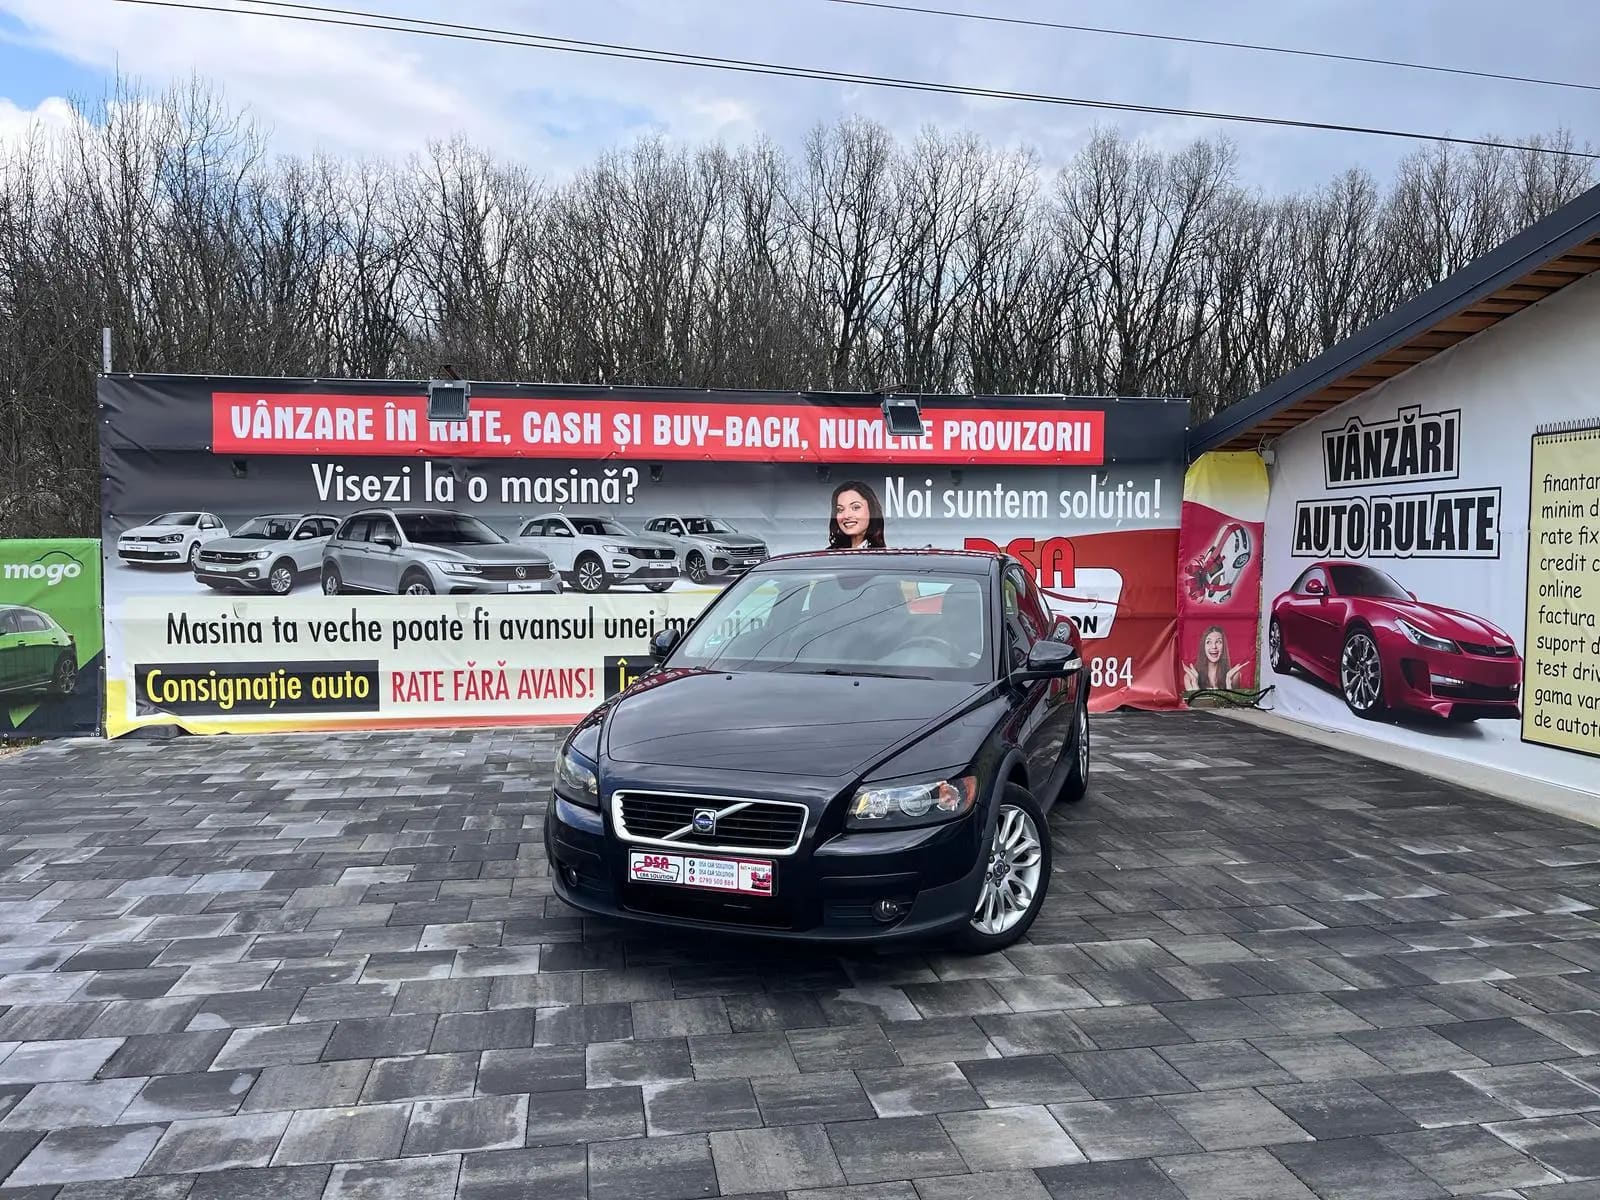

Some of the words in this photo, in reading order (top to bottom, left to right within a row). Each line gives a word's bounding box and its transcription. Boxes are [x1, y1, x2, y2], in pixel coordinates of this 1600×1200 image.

[231, 399, 374, 441] VÂNZARE
[384, 402, 416, 441] ÎN
[429, 411, 511, 445] RATE,
[523, 411, 601, 444] CASH
[613, 413, 641, 452] ȘI
[653, 415, 808, 450] BUY-BACK,
[944, 420, 1091, 452] PROVIZORII
[1327, 413, 1455, 482] VÂNZĂRI
[311, 463, 410, 502] Visezi
[424, 461, 454, 502] la
[468, 476, 488, 503] o
[501, 466, 639, 511] mașină?
[885, 476, 932, 518] Noi
[943, 483, 1048, 518] suntem
[1060, 474, 1161, 527] soluția!
[1541, 500, 1584, 519] minim
[1296, 503, 1365, 551] AUTO
[1373, 496, 1495, 551] RULATE
[1540, 528, 1573, 545] rate
[1578, 525, 1599, 545] fix
[4, 562, 81, 586] mogo
[964, 537, 1075, 588] SA
[1540, 553, 1586, 572] credit
[1538, 579, 1582, 598] online
[167, 612, 262, 644] Masina
[272, 615, 298, 643] ta
[308, 607, 382, 642] veche
[393, 614, 463, 649] poate
[473, 606, 490, 641] fi
[500, 606, 594, 640] avansul
[604, 610, 655, 639] unei
[1538, 604, 1595, 627] factura
[1536, 635, 1585, 656] suport
[1090, 657, 1133, 688] 884
[1536, 658, 1567, 678] test
[146, 668, 301, 709] Consignație
[311, 670, 369, 699] auto
[392, 671, 444, 703] RATE
[453, 660, 510, 701] FĂRĂ
[517, 668, 594, 700] AVANS!
[1534, 687, 1572, 706] gama
[1534, 709, 1551, 728] de
[1556, 717, 1600, 738] autot
[644, 855, 669, 869] DSA
